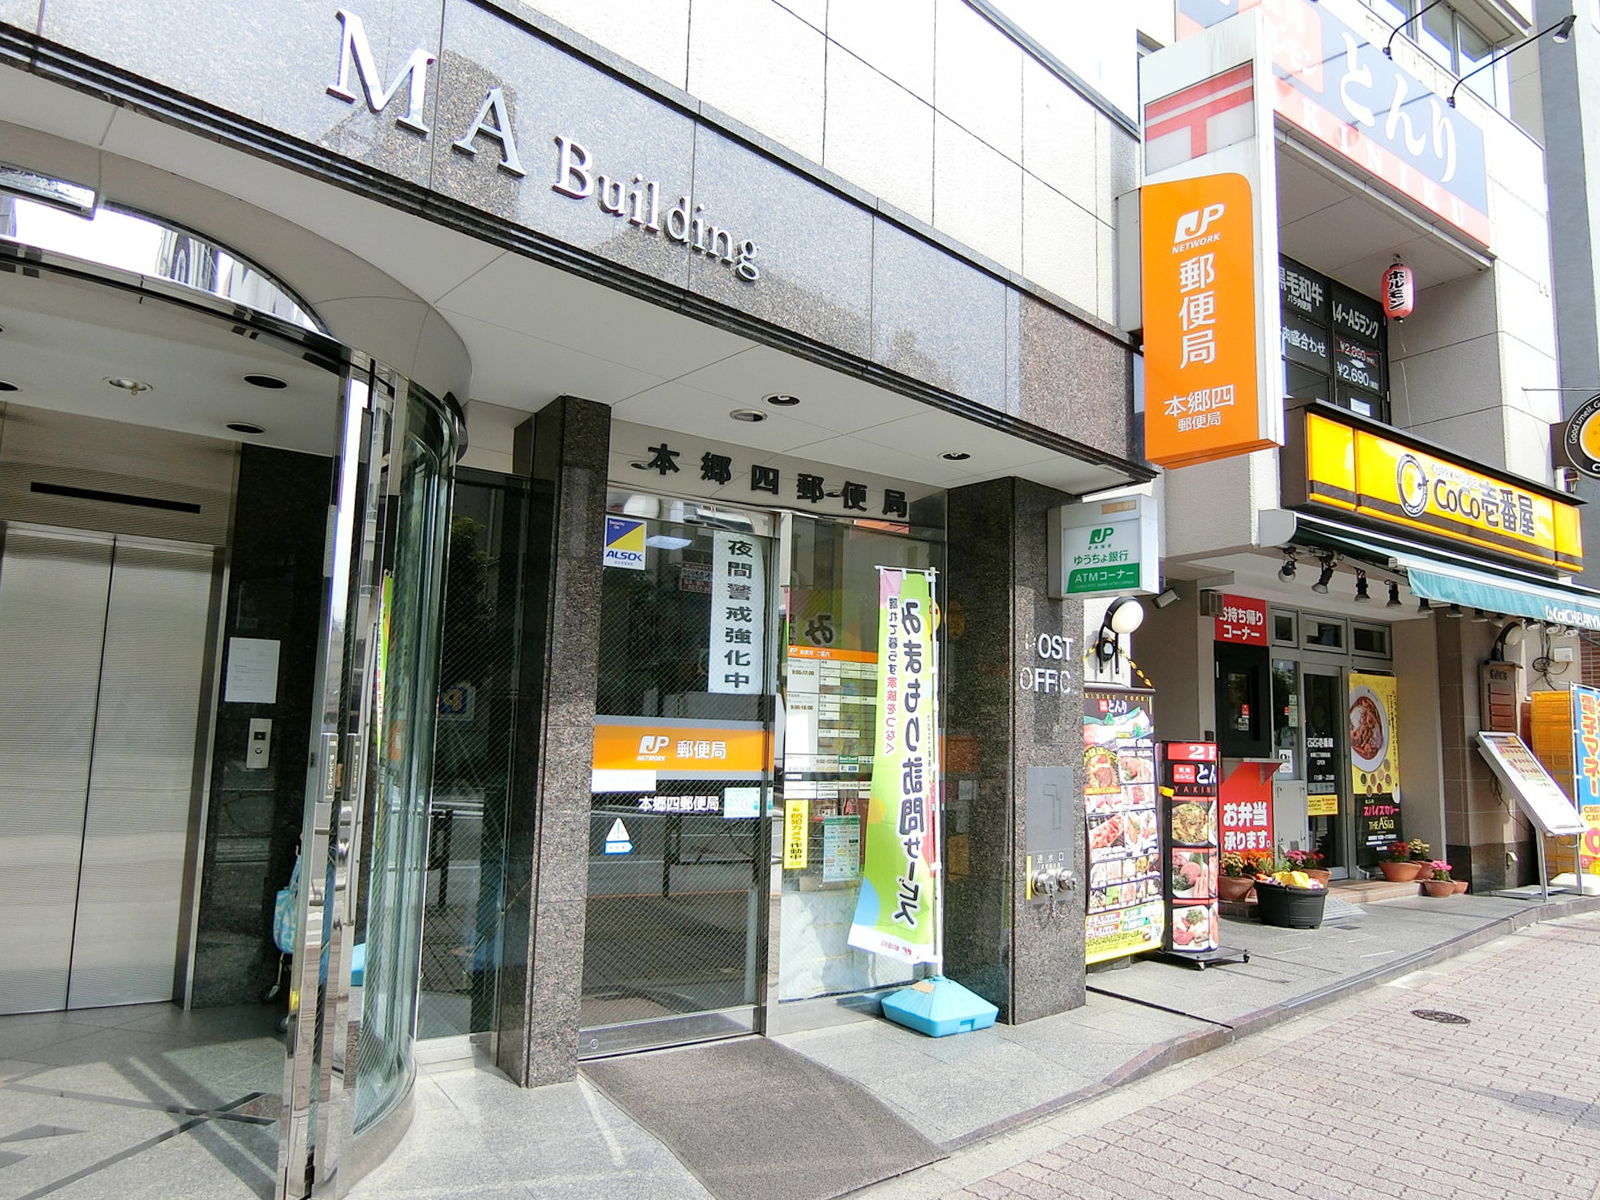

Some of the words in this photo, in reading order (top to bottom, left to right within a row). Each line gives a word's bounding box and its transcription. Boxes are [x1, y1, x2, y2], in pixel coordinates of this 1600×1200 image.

[1339, 31, 1457, 184] とんり
[552, 135, 761, 283] Building
[1171, 232, 1221, 255] NETWORK
[1279, 265, 1325, 308] 黒毛和牛
[1387, 269, 1406, 312] ホルモン
[1178, 252, 1216, 370] 郵便局
[1280, 325, 1326, 358] 肉盛合わせ
[1336, 361, 1370, 386] ¥2,690
[1163, 384, 1235, 418] 本郷四
[1177, 411, 1221, 433] 郵便局
[647, 442, 909, 519] 本郷四郵便局
[1433, 478, 1535, 538] CoCo壱番屋
[606, 550, 643, 562] ALSOK
[1073, 549, 1129, 566] ゆうちょ銀行
[1074, 569, 1134, 583] ATMコーナー
[723, 539, 754, 689] 夜間警戒強化中
[1223, 624, 1260, 640] コーナー
[1019, 666, 1077, 694] OFFIC
[1108, 699, 1128, 714] とんり
[636, 754, 667, 762] NETWORK
[676, 740, 727, 760] 郵便局
[638, 795, 719, 812] 本郷四郵便局
[1223, 801, 1268, 827] お弁当
[1224, 830, 1271, 851] 承ります。
